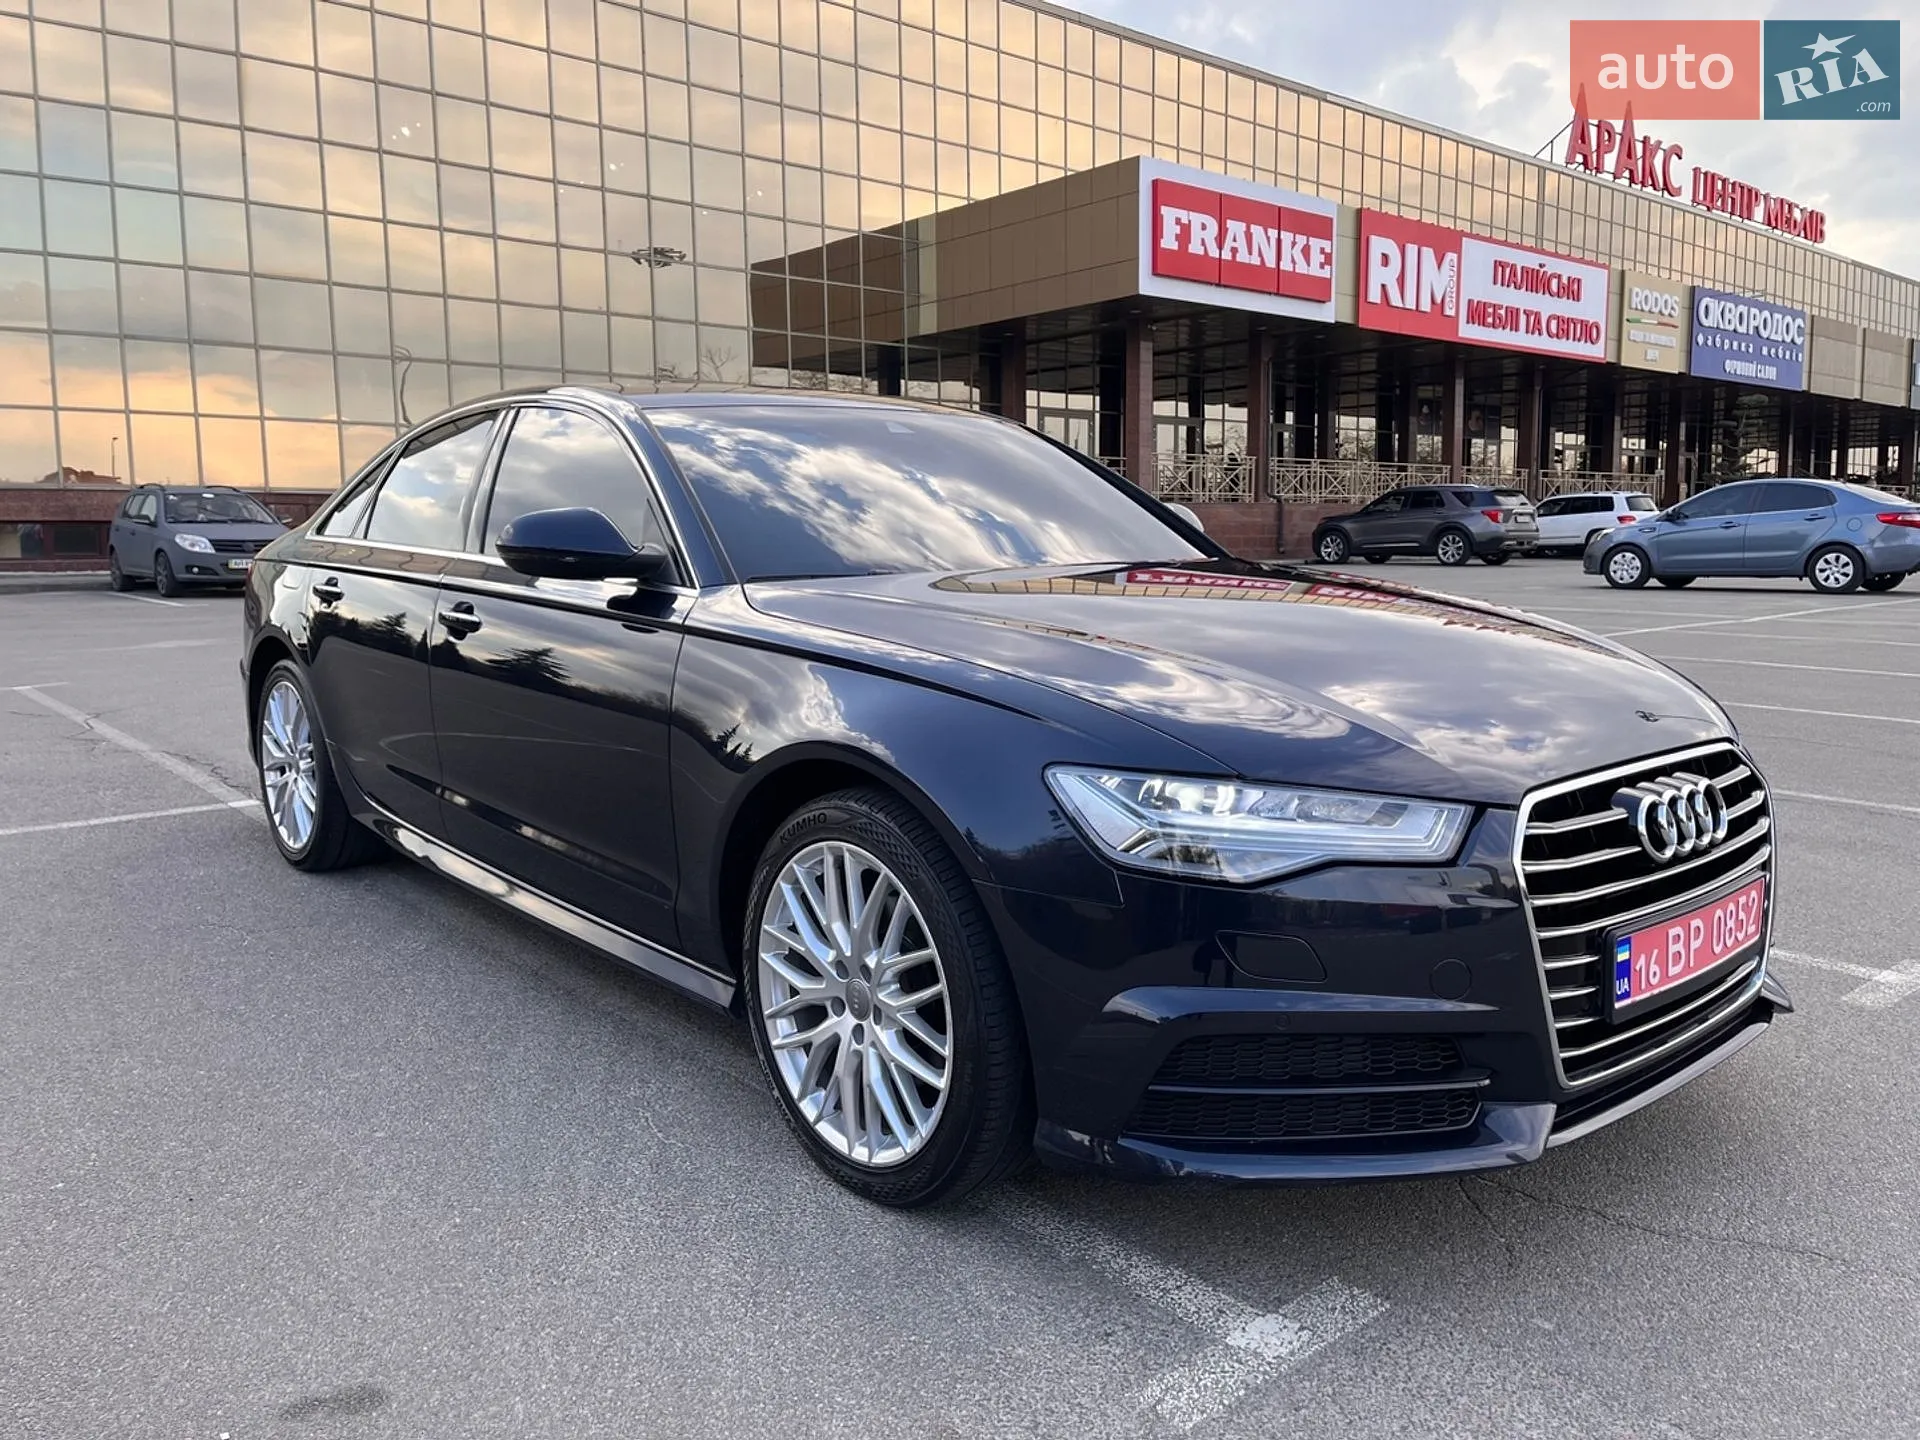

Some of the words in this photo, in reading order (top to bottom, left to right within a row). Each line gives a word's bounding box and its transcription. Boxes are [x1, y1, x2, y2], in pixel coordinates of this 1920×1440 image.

[1564, 82, 1683, 197] АРАКС
[1691, 166, 1761, 213] ЦЕНТР
[1763, 191, 1827, 244] МЕБЛІВ
[1159, 205, 1333, 279] FRANKE
[1366, 234, 1458, 317] RIM
[1448, 258, 1457, 311] GROUP
[1492, 259, 1583, 303] ІТАЛІЙСЬКІ
[1465, 298, 1521, 333] МЕБЛІ
[1523, 308, 1544, 337] ТА
[1545, 313, 1602, 346] СВІТЛО
[1629, 286, 1680, 318] RODOS
[779, 811, 828, 844] KUMHO
[1633, 947, 1661, 991] 16
[1711, 889, 1759, 956] 0852
[1615, 979, 1630, 995] UA
